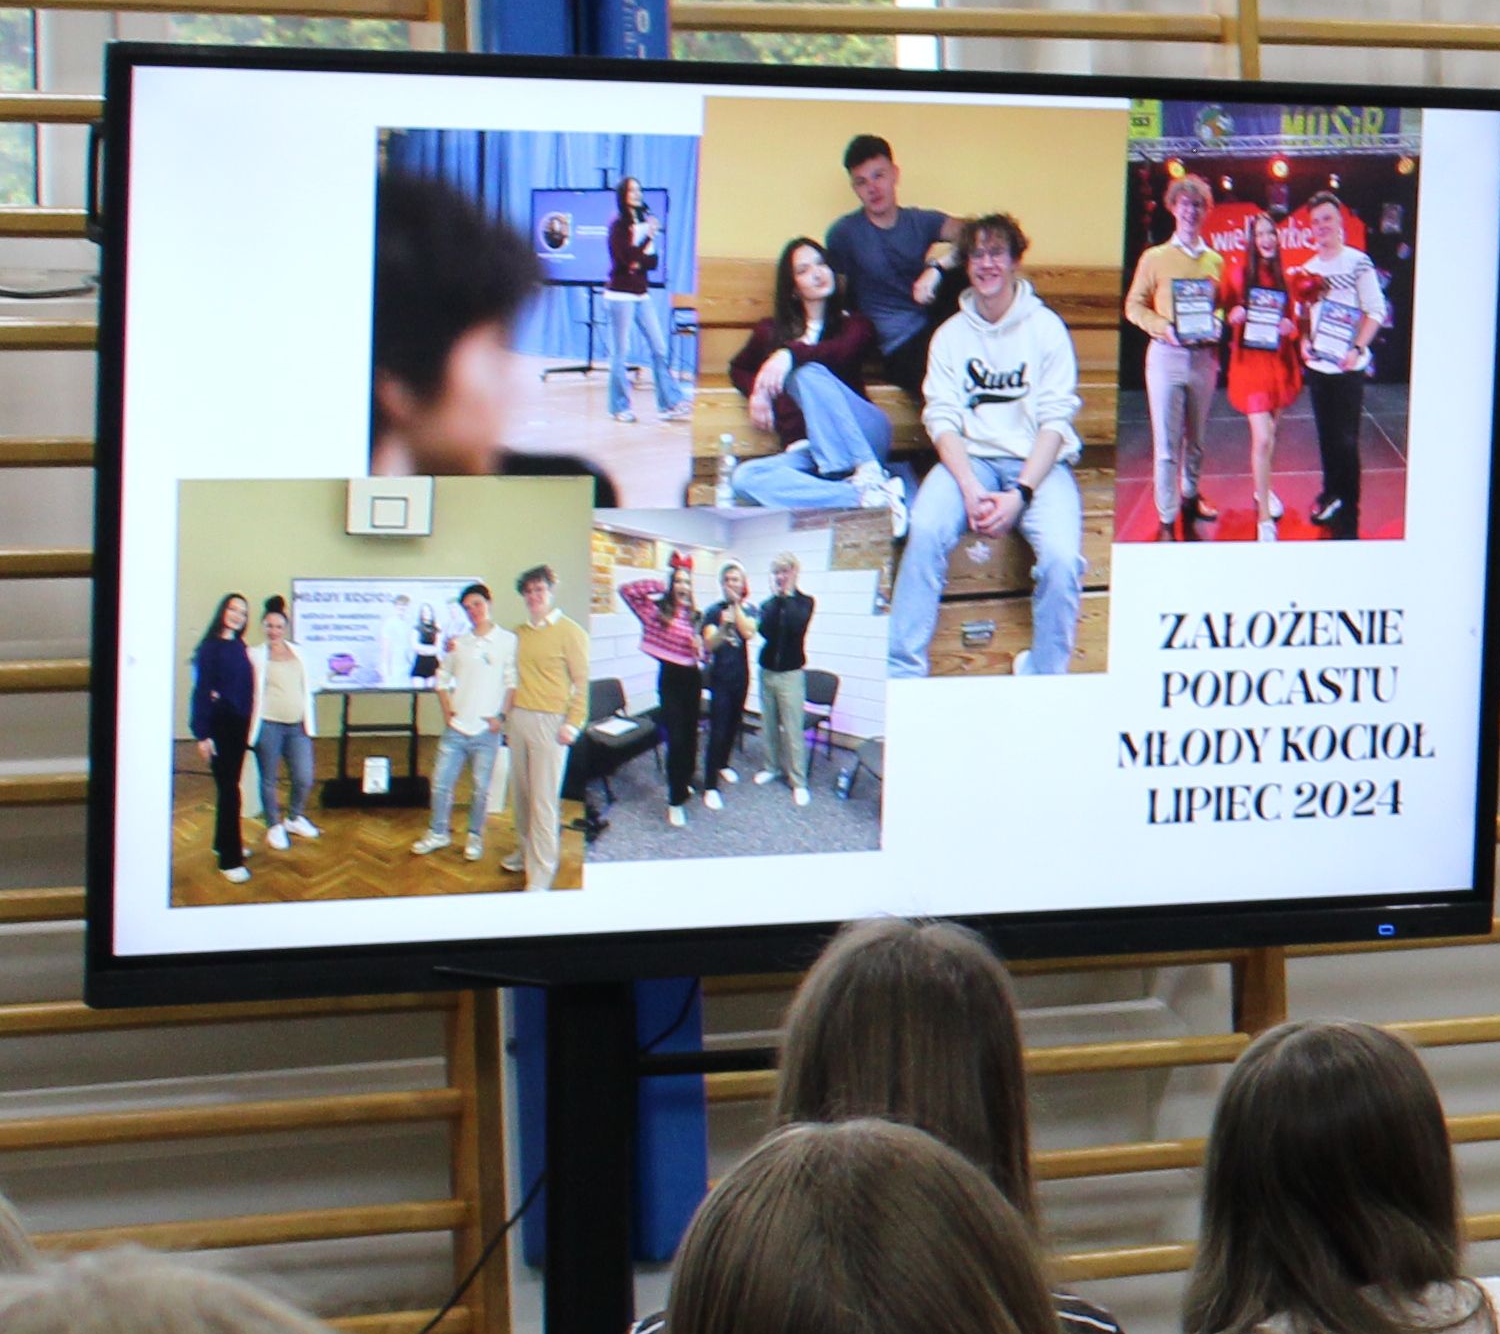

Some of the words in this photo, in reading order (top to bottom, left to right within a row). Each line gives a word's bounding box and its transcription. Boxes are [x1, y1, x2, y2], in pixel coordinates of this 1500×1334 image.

[1159, 601, 1404, 650] ZAŁOŻENIE
[1161, 666, 1399, 708] PODCASTU
[1117, 727, 1271, 768] MŁODY
[1280, 722, 1436, 763] KOCIOŁ
[1146, 783, 1283, 825] LIPIEC
[1292, 779, 1404, 819] 2024
